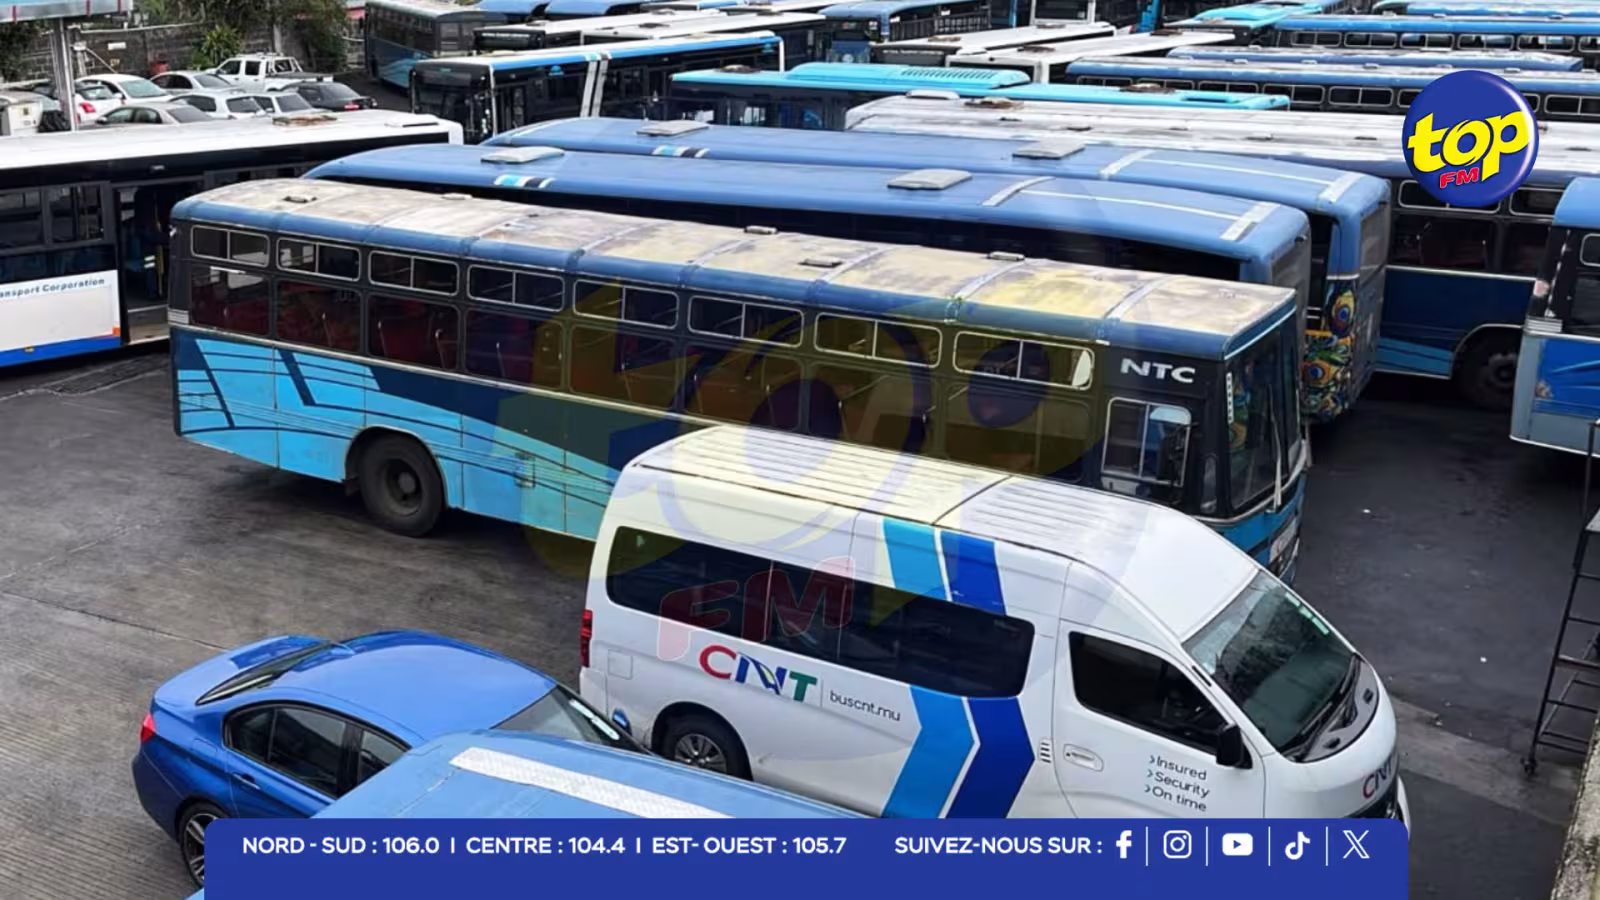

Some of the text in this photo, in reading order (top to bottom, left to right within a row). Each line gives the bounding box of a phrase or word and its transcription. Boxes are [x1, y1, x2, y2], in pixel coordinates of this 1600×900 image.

[42, 278, 105, 292] Corporation
[1120, 357, 1196, 384] NTC
[698, 644, 901, 722] CNT buscnt.mu
[1156, 755, 1207, 781] Insured
[1151, 785, 1207, 812] On time
[1154, 771, 1211, 799] Security
